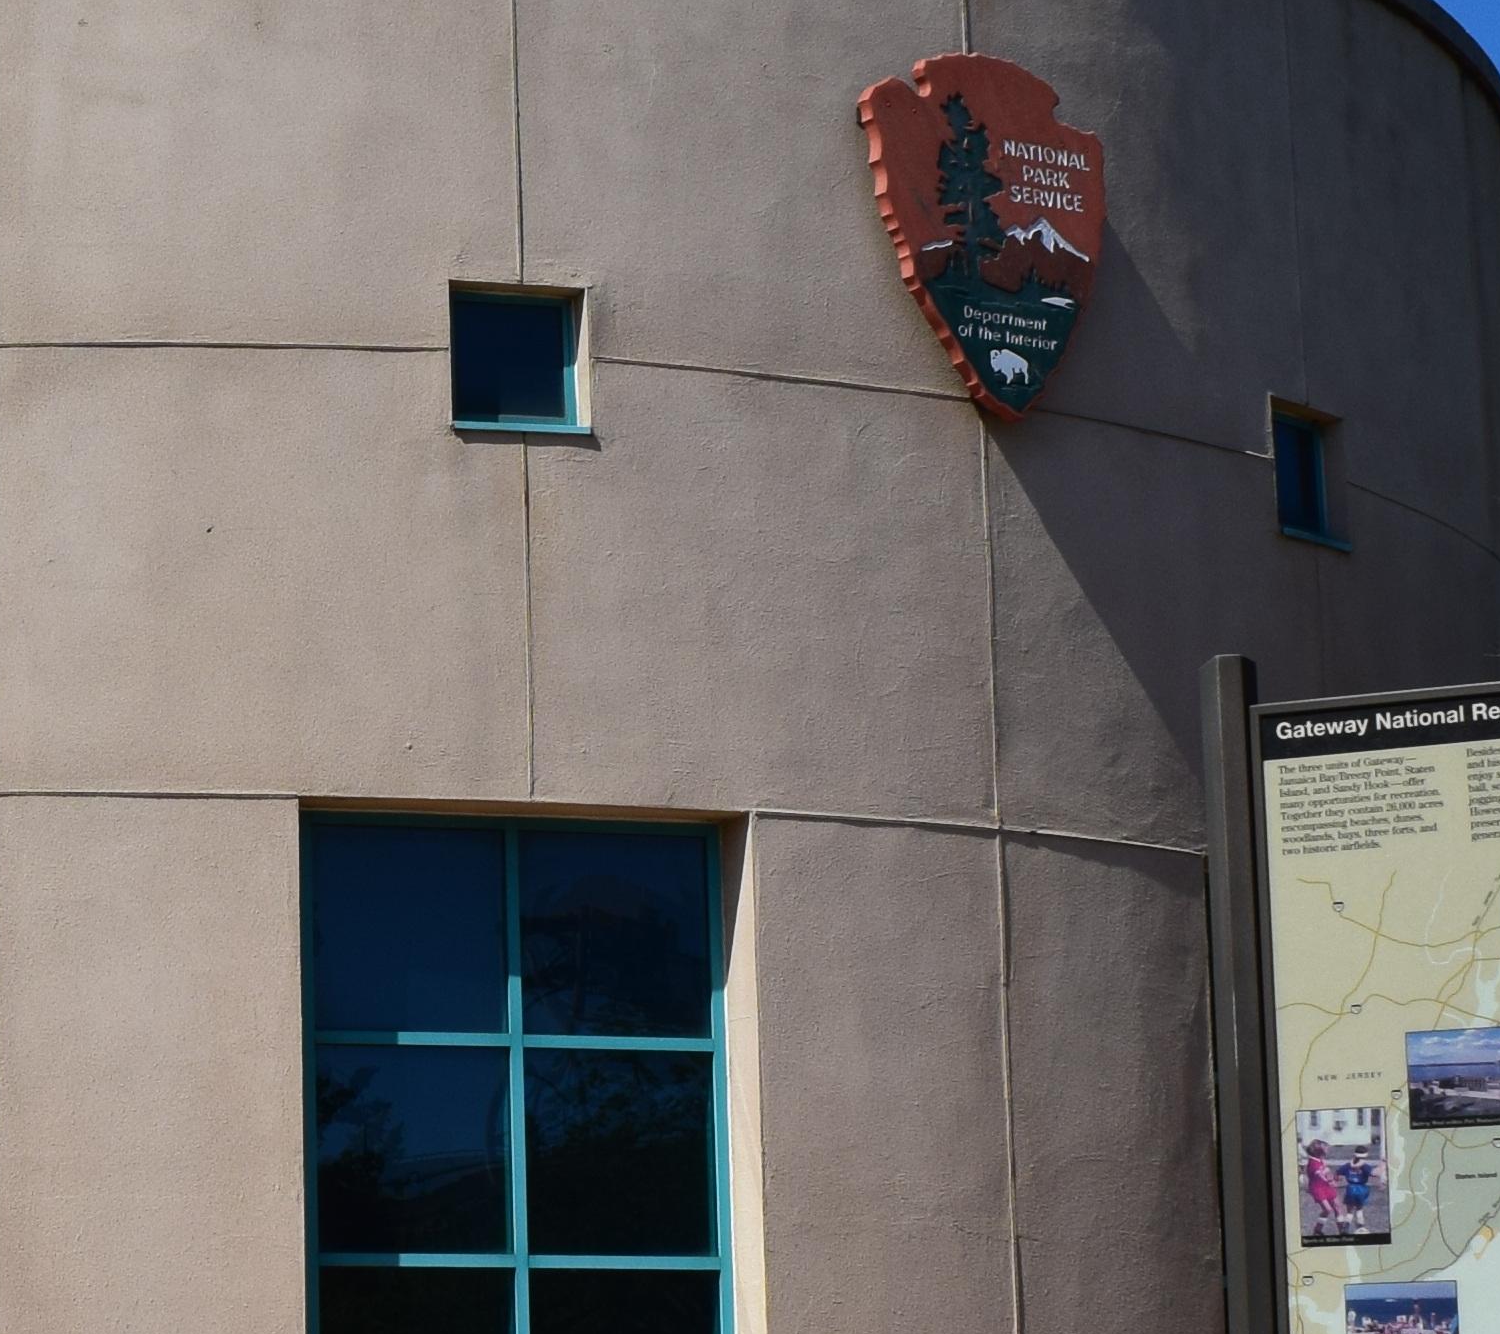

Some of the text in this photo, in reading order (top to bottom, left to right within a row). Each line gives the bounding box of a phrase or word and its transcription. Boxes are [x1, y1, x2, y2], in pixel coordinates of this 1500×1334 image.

[1004, 139, 1090, 172] NATIONAL
[1023, 166, 1070, 188] PARK
[1010, 185, 1085, 213] SERVICE
[963, 305, 1048, 330] Department
[958, 324, 1058, 351] of the Interior
[1275, 719, 1368, 739] Gateway
[1376, 706, 1464, 730] National
[1317, 1071, 1383, 1082] NEW JERSEY
